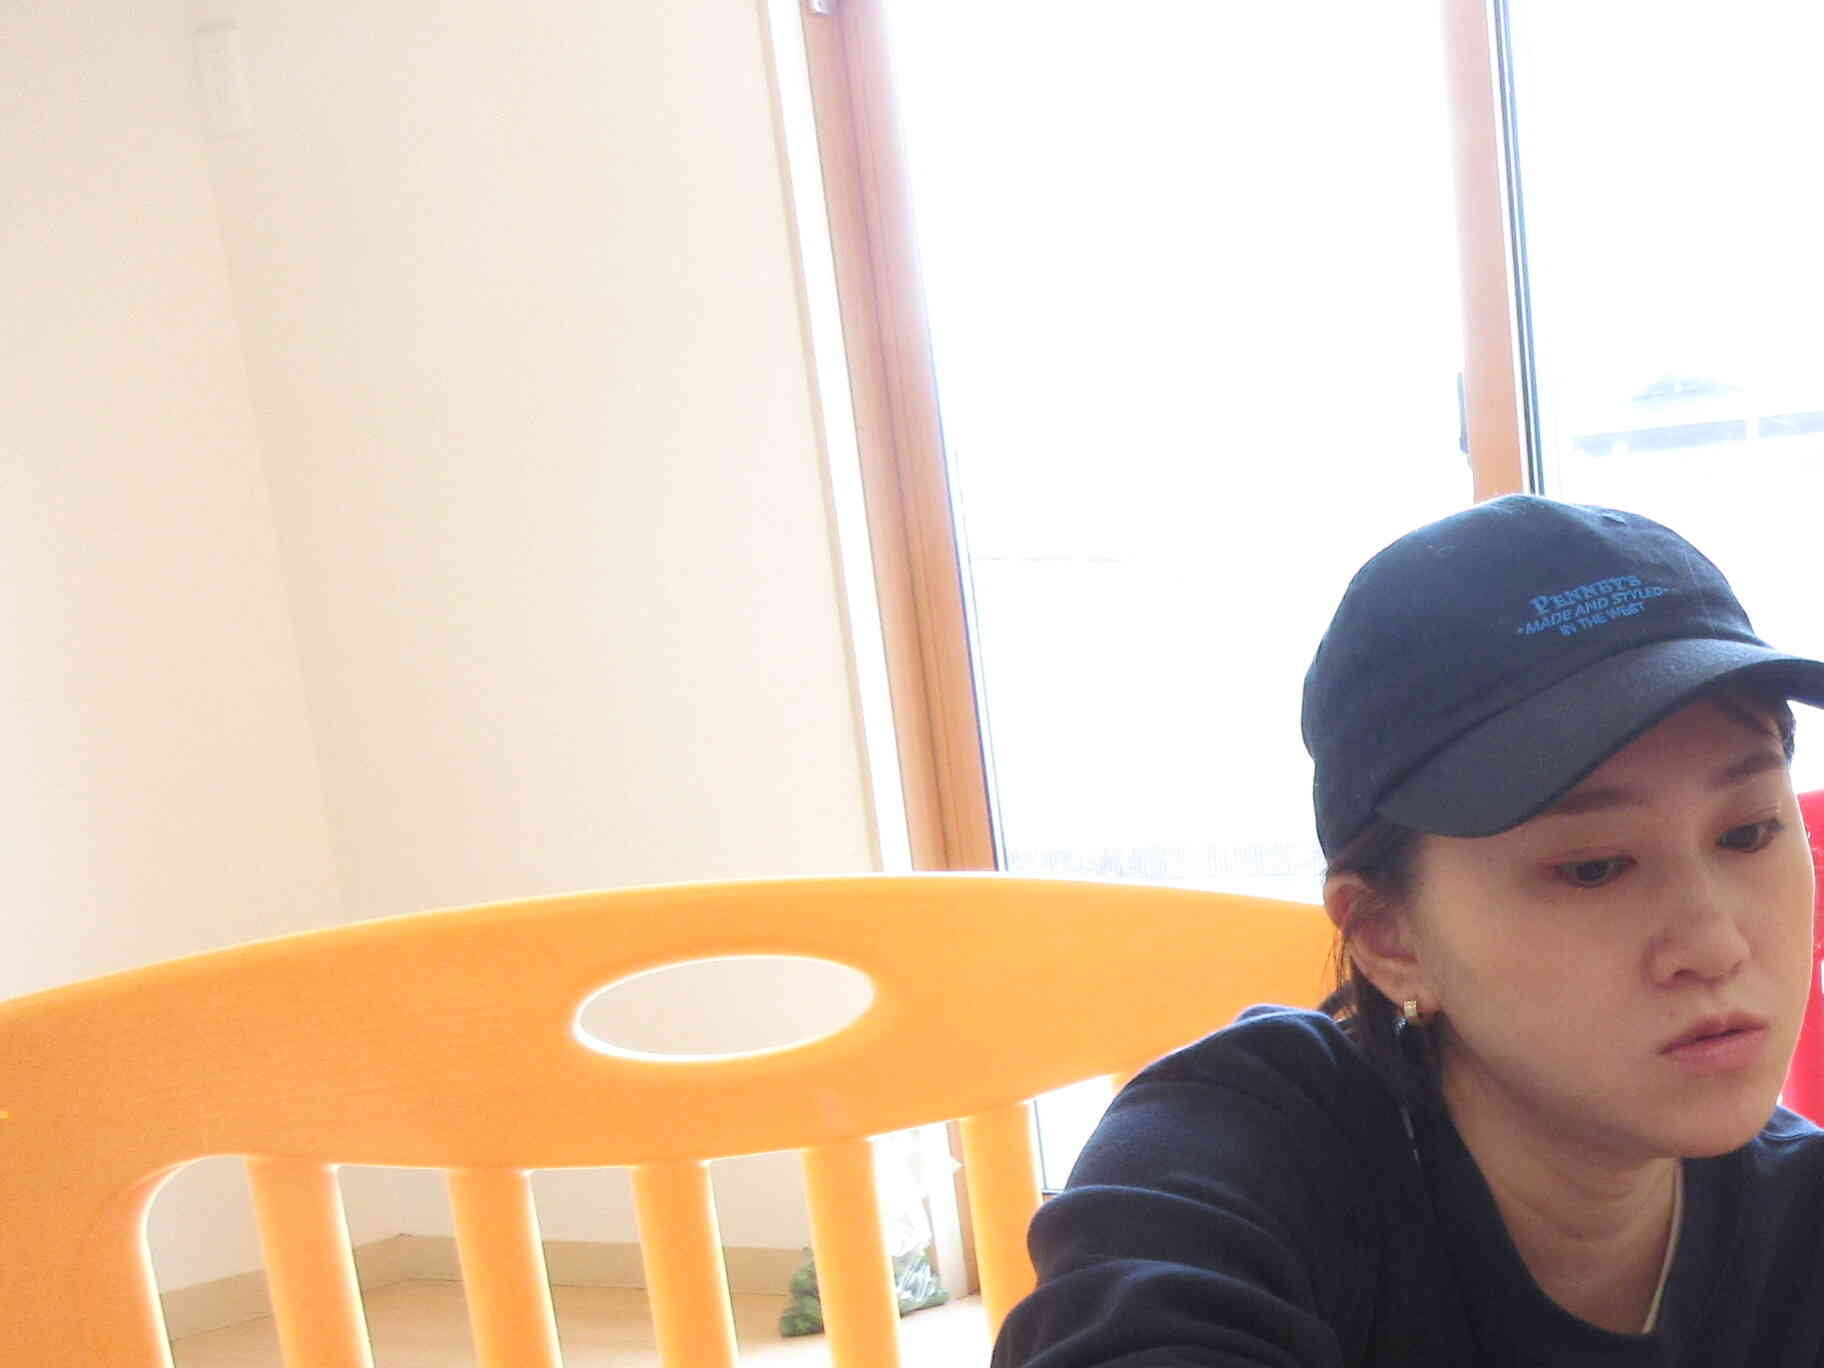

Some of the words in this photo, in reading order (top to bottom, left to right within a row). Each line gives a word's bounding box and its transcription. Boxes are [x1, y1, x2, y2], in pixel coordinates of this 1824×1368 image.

[1525, 611, 1572, 635] MADE
[1575, 598, 1609, 618] AND
[1610, 586, 1665, 604] STYLED
[1577, 613, 1608, 630] THE
[1606, 602, 1645, 618] WEST
